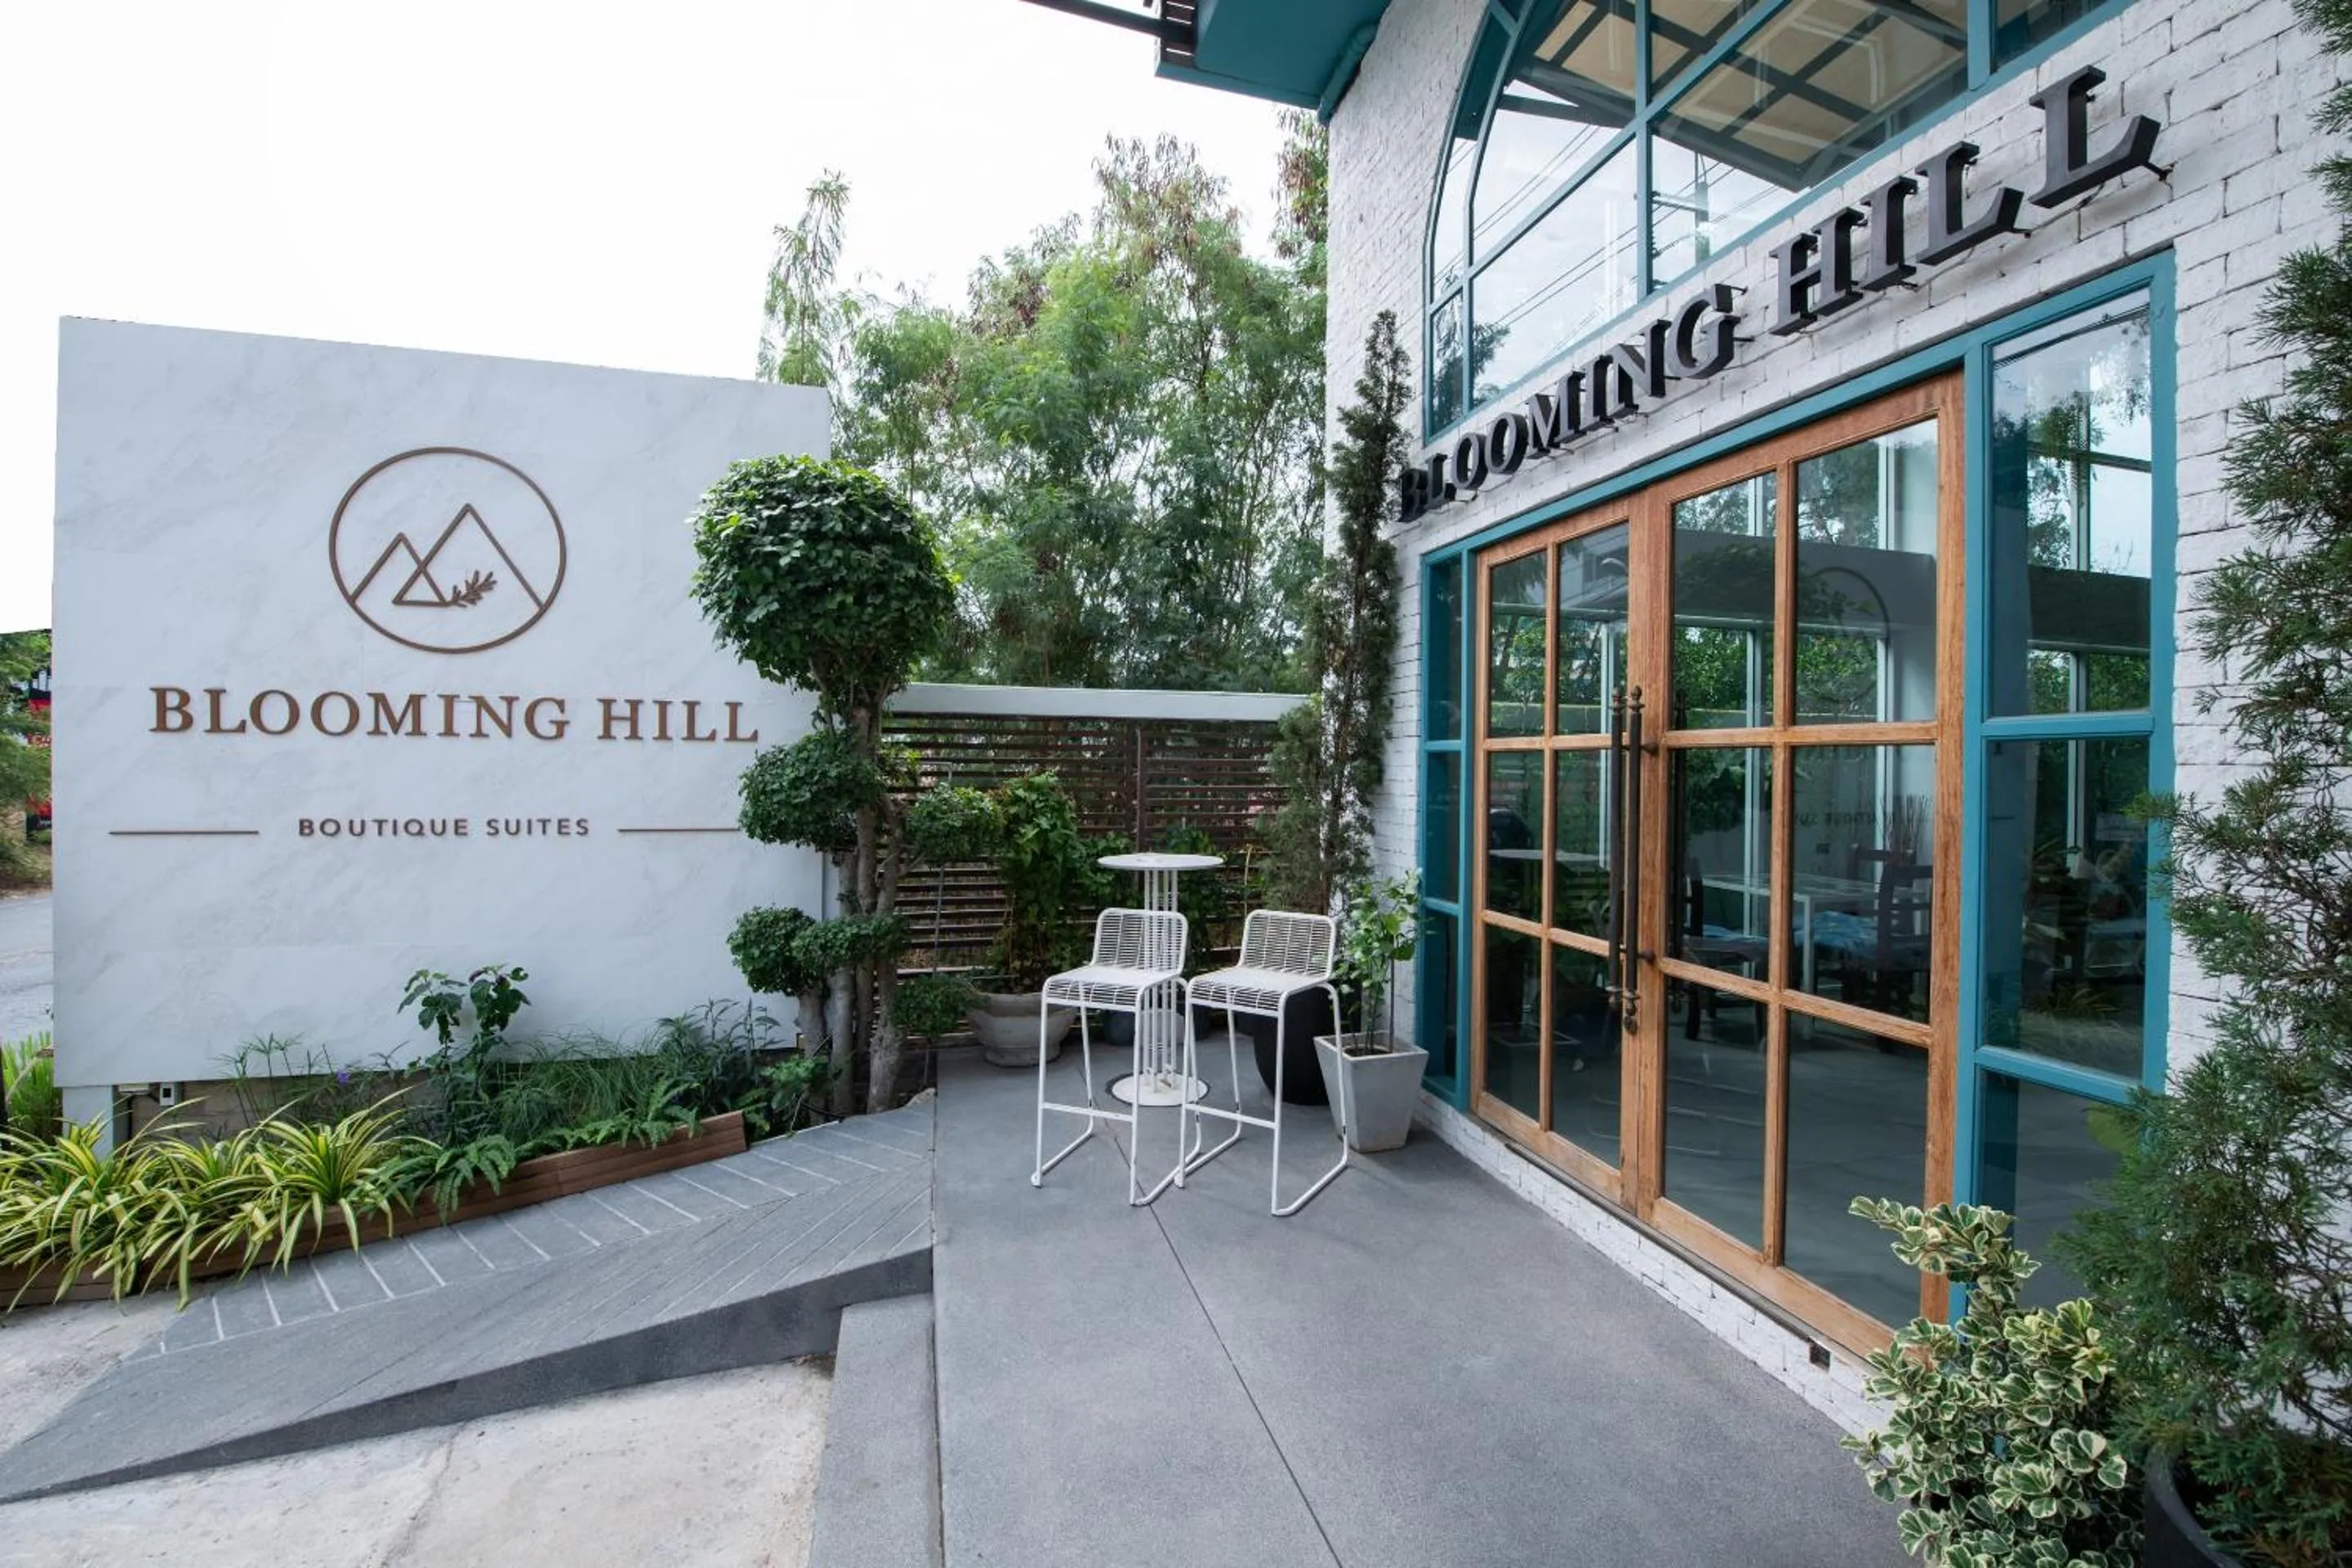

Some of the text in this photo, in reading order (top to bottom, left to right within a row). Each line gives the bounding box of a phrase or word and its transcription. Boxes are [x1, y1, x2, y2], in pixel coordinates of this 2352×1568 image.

[1398, 65, 2161, 523] BLOOMING HILL
[149, 686, 760, 742] BLOOMING HILL
[297, 817, 590, 838] BOUTIQUE SUITES
